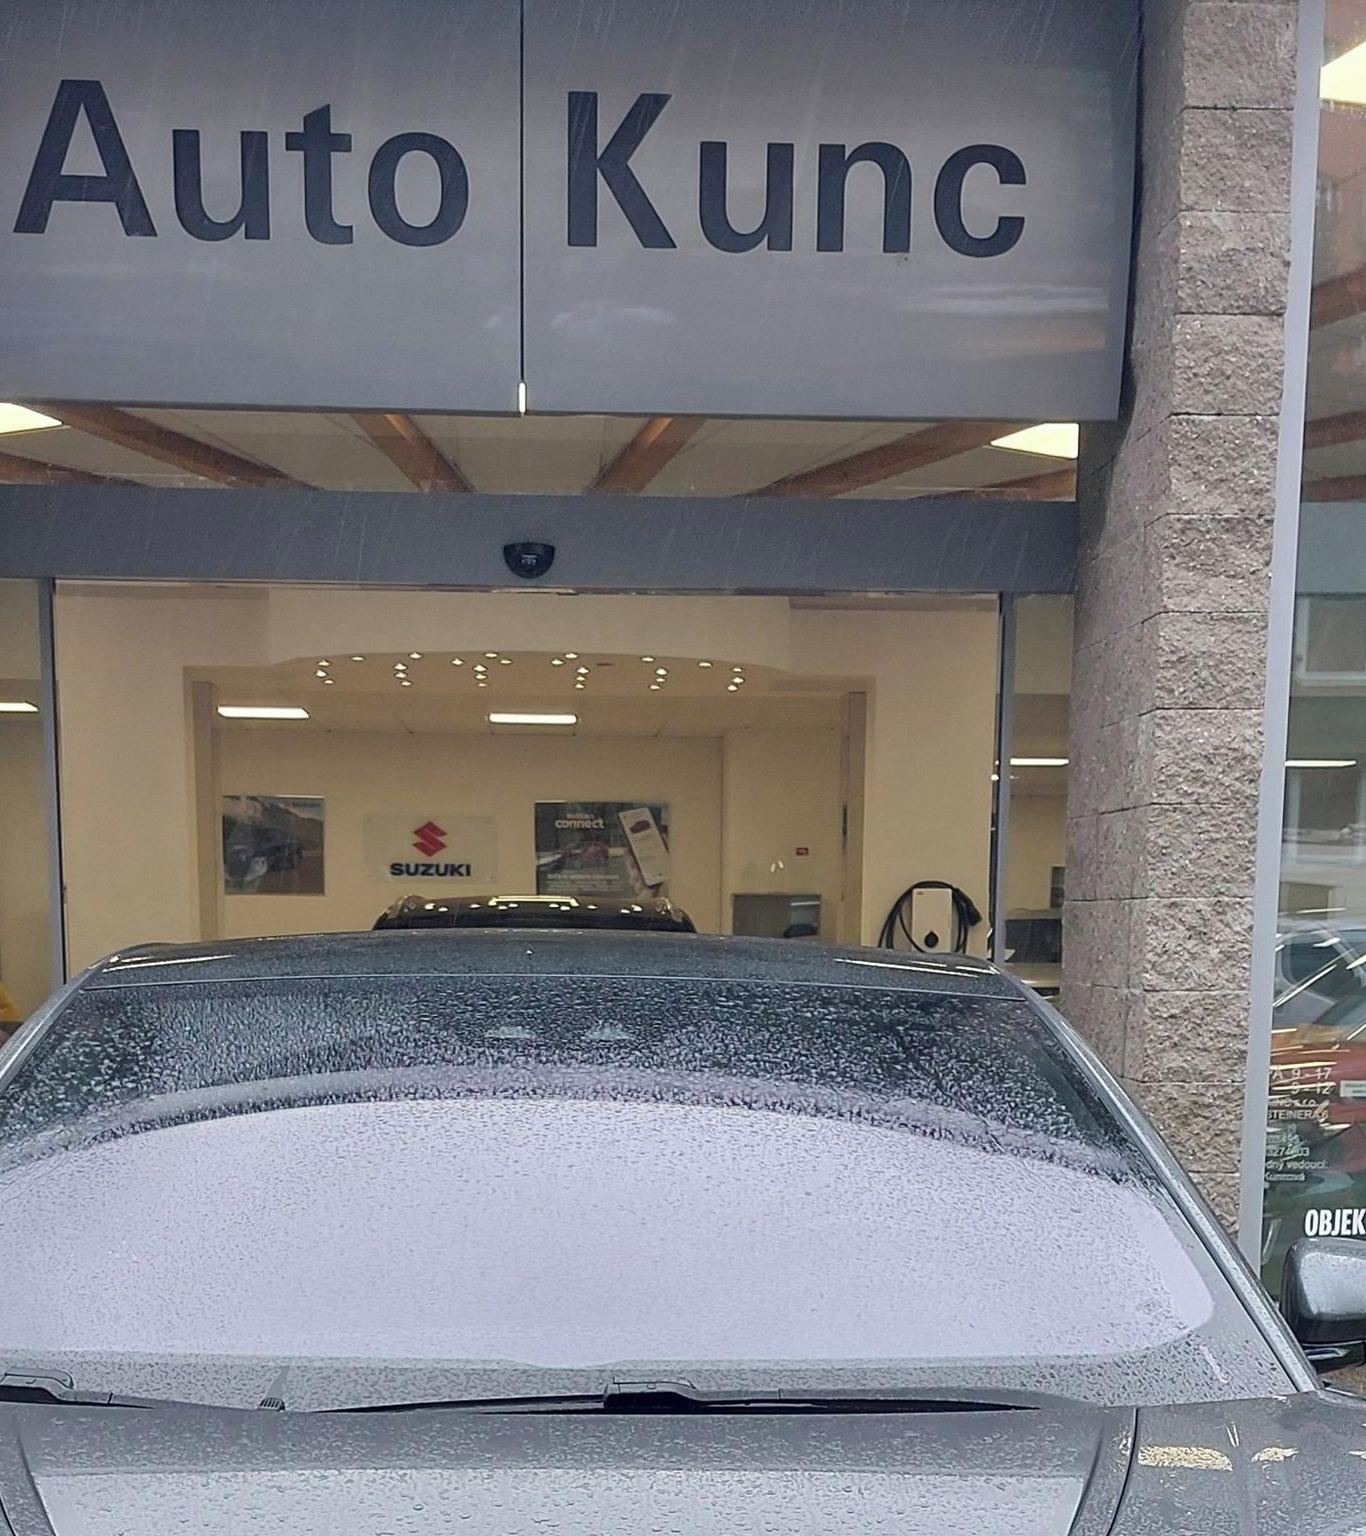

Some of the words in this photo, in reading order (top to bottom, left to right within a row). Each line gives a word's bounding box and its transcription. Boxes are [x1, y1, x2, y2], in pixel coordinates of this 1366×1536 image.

[13, 78, 470, 247] Auto
[566, 90, 1027, 259] Kunc
[555, 817, 605, 829] connect
[389, 862, 471, 877] SUZUKI
